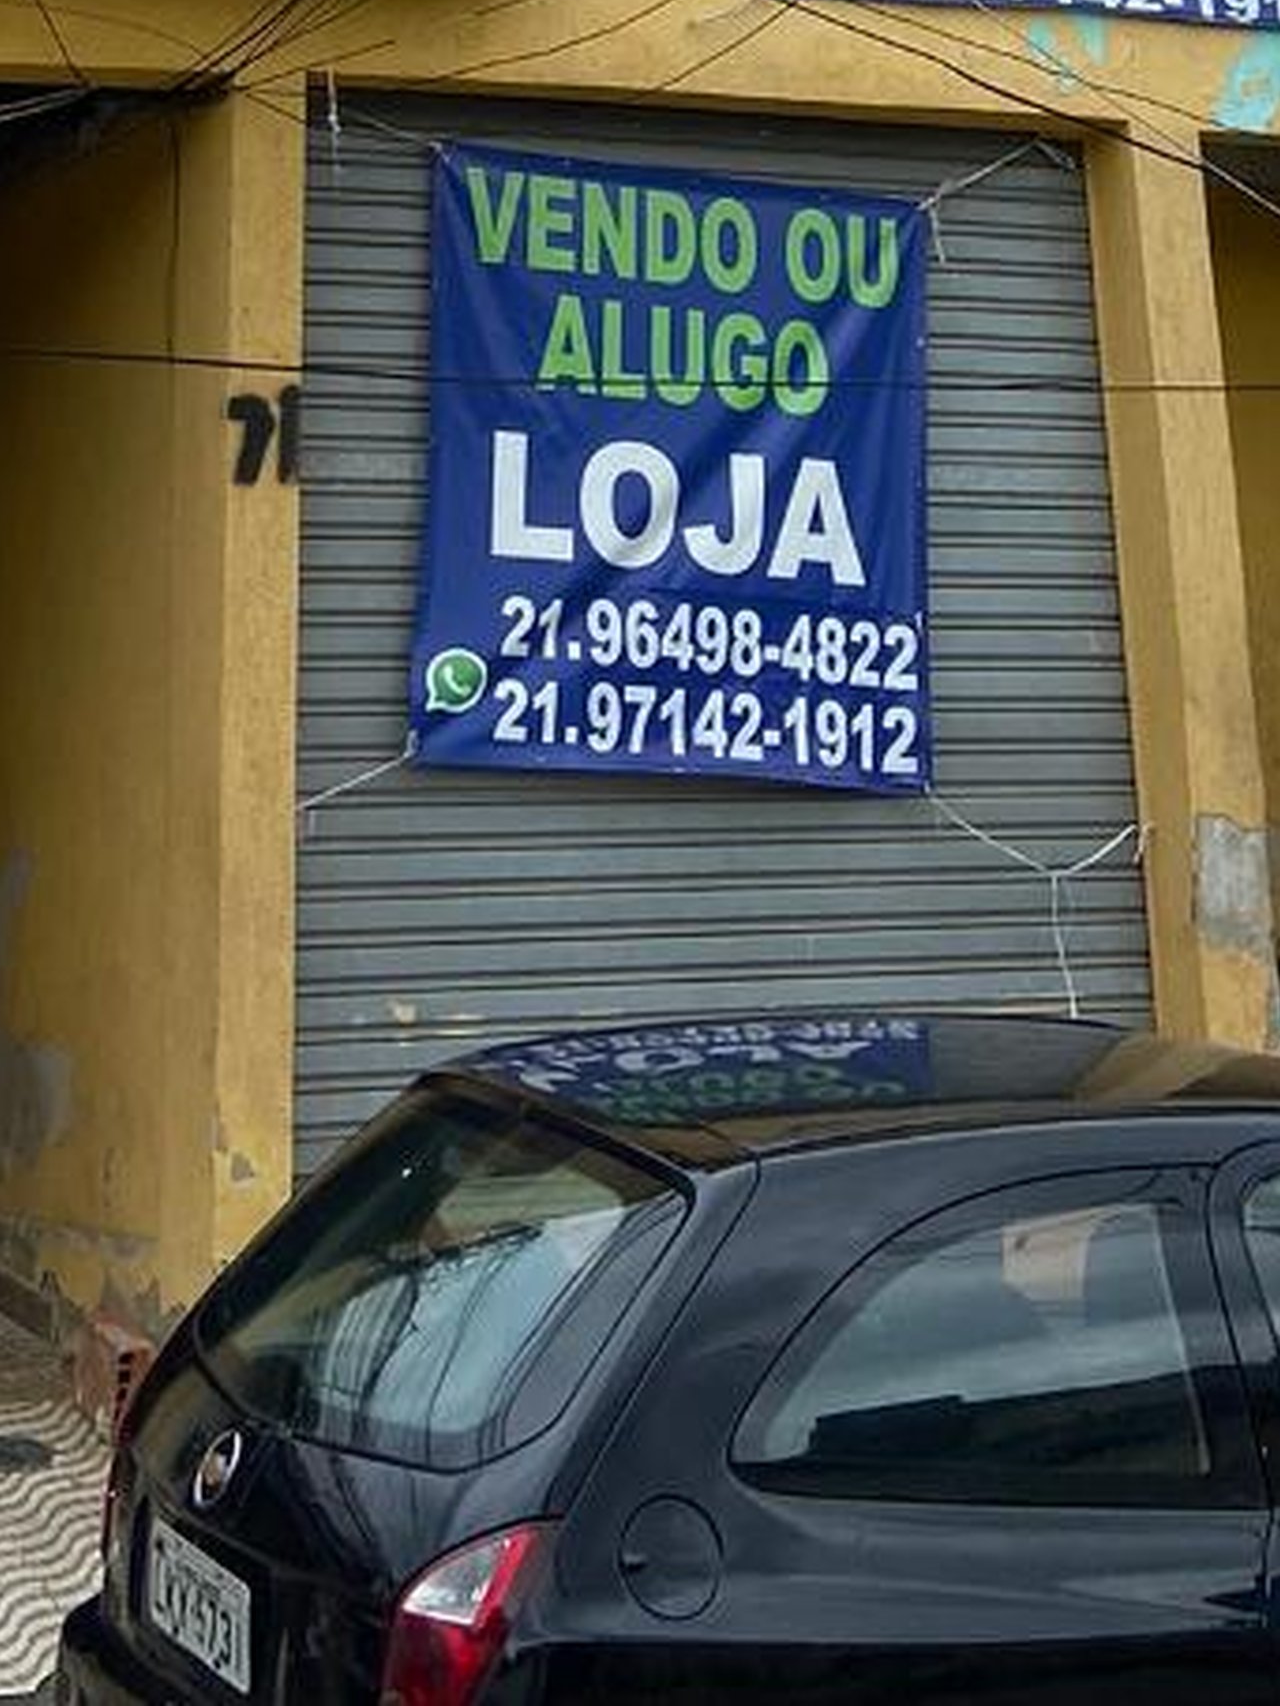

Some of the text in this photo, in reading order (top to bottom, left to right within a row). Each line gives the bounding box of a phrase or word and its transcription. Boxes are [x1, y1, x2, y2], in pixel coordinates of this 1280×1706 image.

[466, 166, 900, 309] VENDO OU
[535, 294, 830, 416] ALUGO
[227, 384, 300, 486] 71
[489, 429, 867, 587] LOJA
[500, 595, 920, 691] 21.96498-4822
[492, 680, 920, 774] 21.97142-1912
